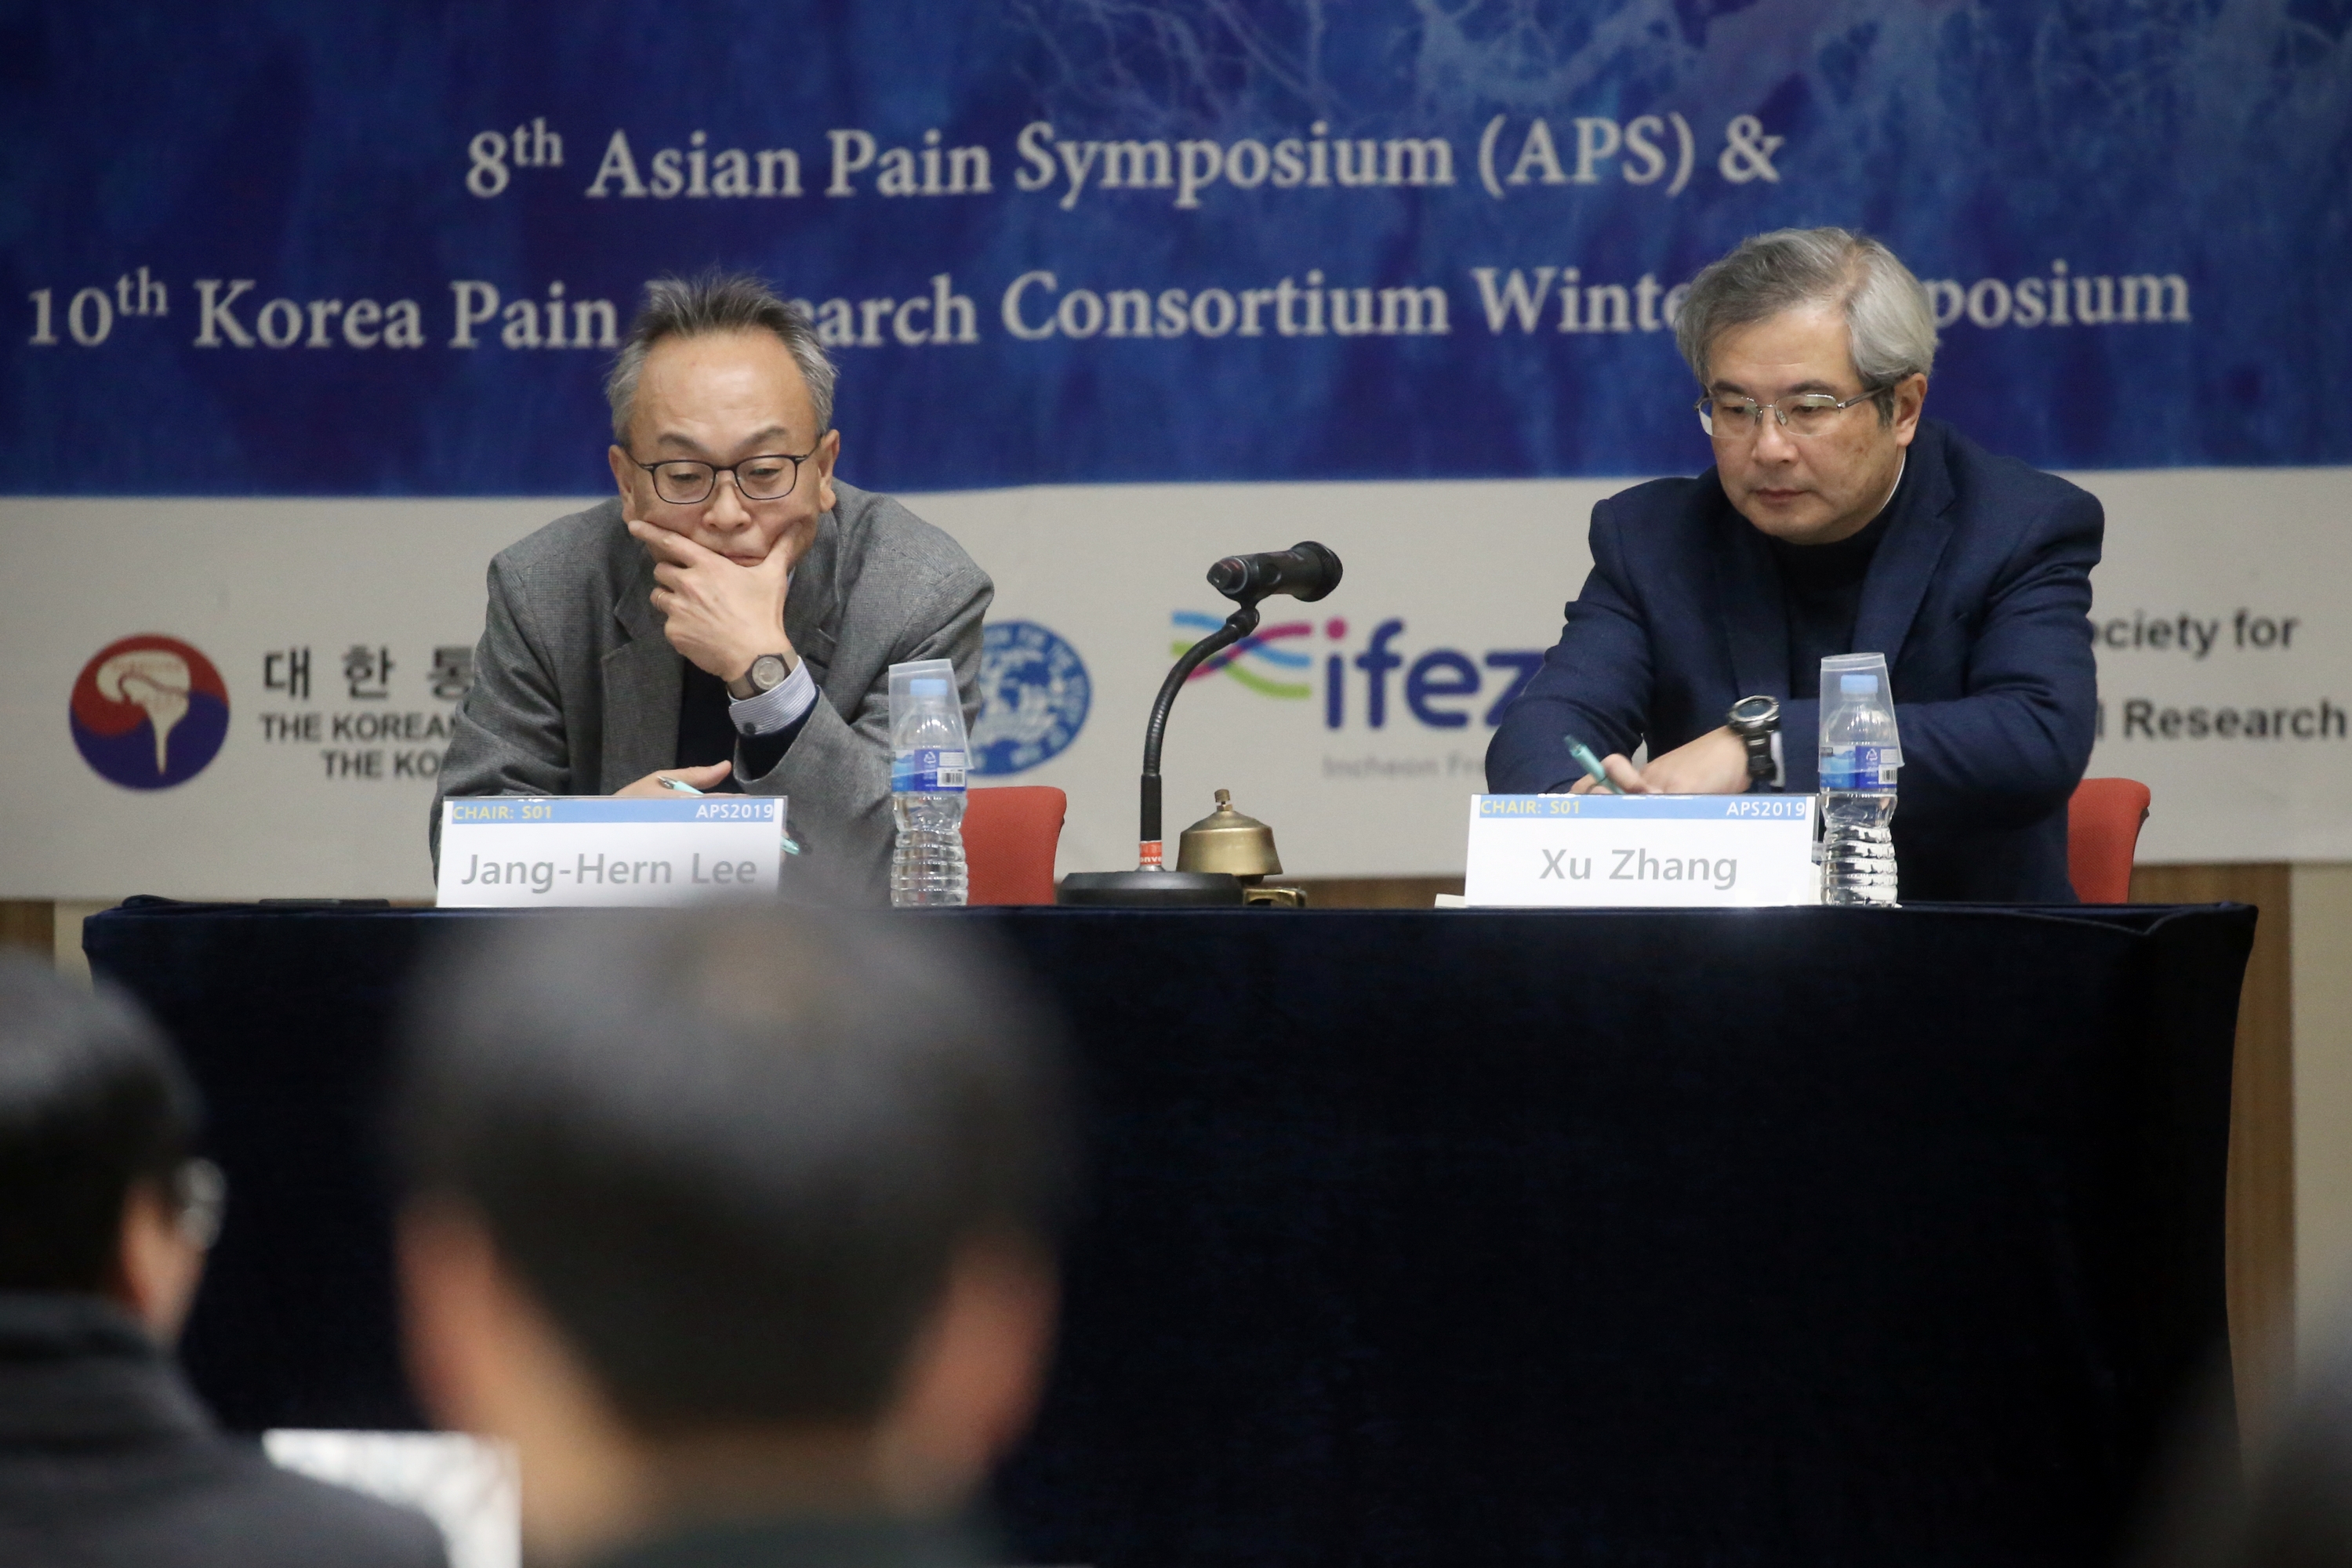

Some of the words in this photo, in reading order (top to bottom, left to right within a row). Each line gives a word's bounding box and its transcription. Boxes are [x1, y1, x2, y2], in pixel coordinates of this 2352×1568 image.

[466, 118, 564, 198] 8th
[585, 129, 803, 198] Asian
[826, 128, 993, 198] Pain
[1014, 120, 1455, 210] Symposium
[1478, 113, 1695, 198] (APS)
[1719, 114, 1785, 183] &
[28, 267, 168, 346] 10th
[194, 279, 424, 349] Korea
[449, 280, 620, 350] Pain
[1000, 270, 1452, 340] Consortium
[2232, 607, 2299, 650] for
[260, 713, 321, 742] THE
[2122, 696, 2349, 741] Research
[322, 750, 383, 779] THE
[452, 806, 514, 820] CHAIR:
[521, 805, 553, 819] S01
[695, 804, 774, 818] APS2019
[1479, 800, 1542, 815] CHAIR:
[1549, 800, 1581, 815] S01
[1726, 801, 1806, 817] APS2019
[461, 853, 672, 894] Jang-Hern
[691, 853, 757, 885] Lee
[1538, 848, 1592, 880] Xu
[1607, 848, 1738, 891] Zhang
